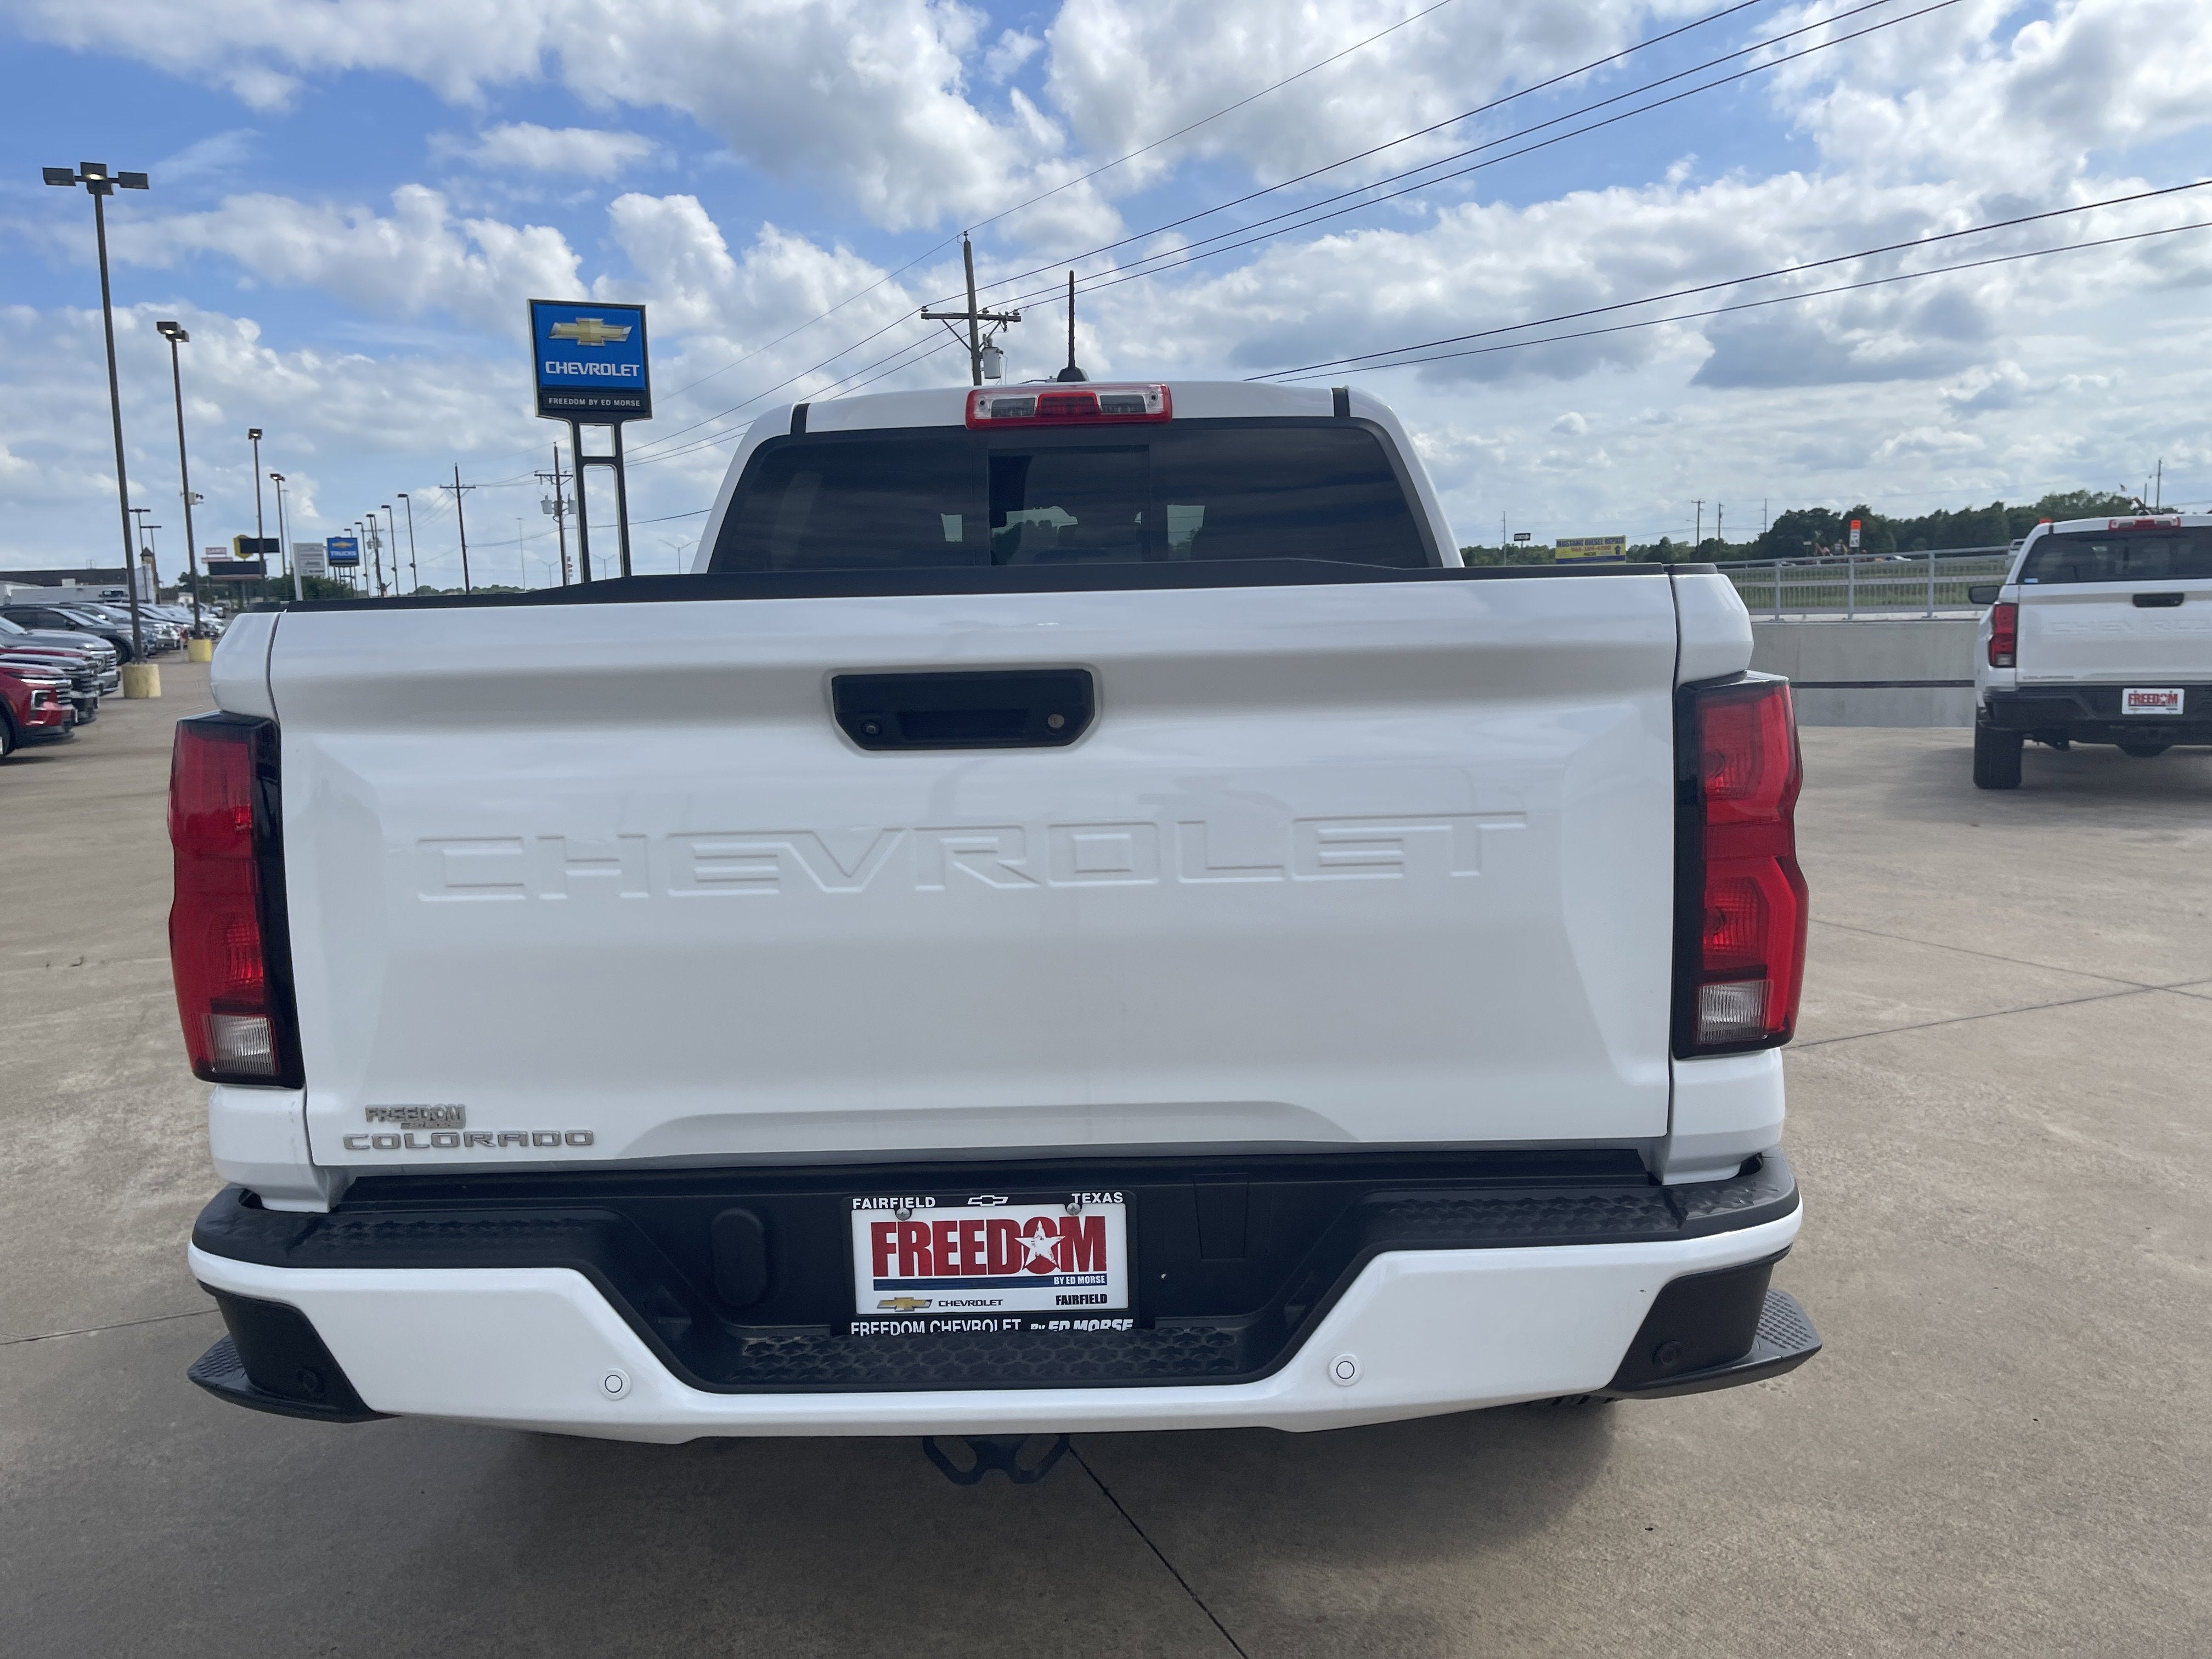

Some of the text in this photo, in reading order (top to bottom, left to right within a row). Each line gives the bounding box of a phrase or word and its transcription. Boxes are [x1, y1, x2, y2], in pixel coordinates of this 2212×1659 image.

[545, 360, 640, 377] CHEVROLET
[549, 397, 585, 405] FREEDOM
[2128, 693, 2178, 705] FREEDOM
[417, 812, 1528, 901] CHEVROLET
[365, 1104, 465, 1123] FREEDOM
[343, 1129, 594, 1150] COLORADO
[853, 1197, 936, 1210] FAIRFIELD
[1071, 1192, 1124, 1204] TEXAS
[871, 1216, 1107, 1277] FREEDOM
[1053, 1276, 1106, 1285] BY ED MORSE
[938, 1299, 1003, 1307] CHEVROLET
[1056, 1294, 1108, 1306] FAIRFIELD
[851, 1320, 926, 1337] FREEDOM
[1073, 1319, 1134, 1333] MORSE
